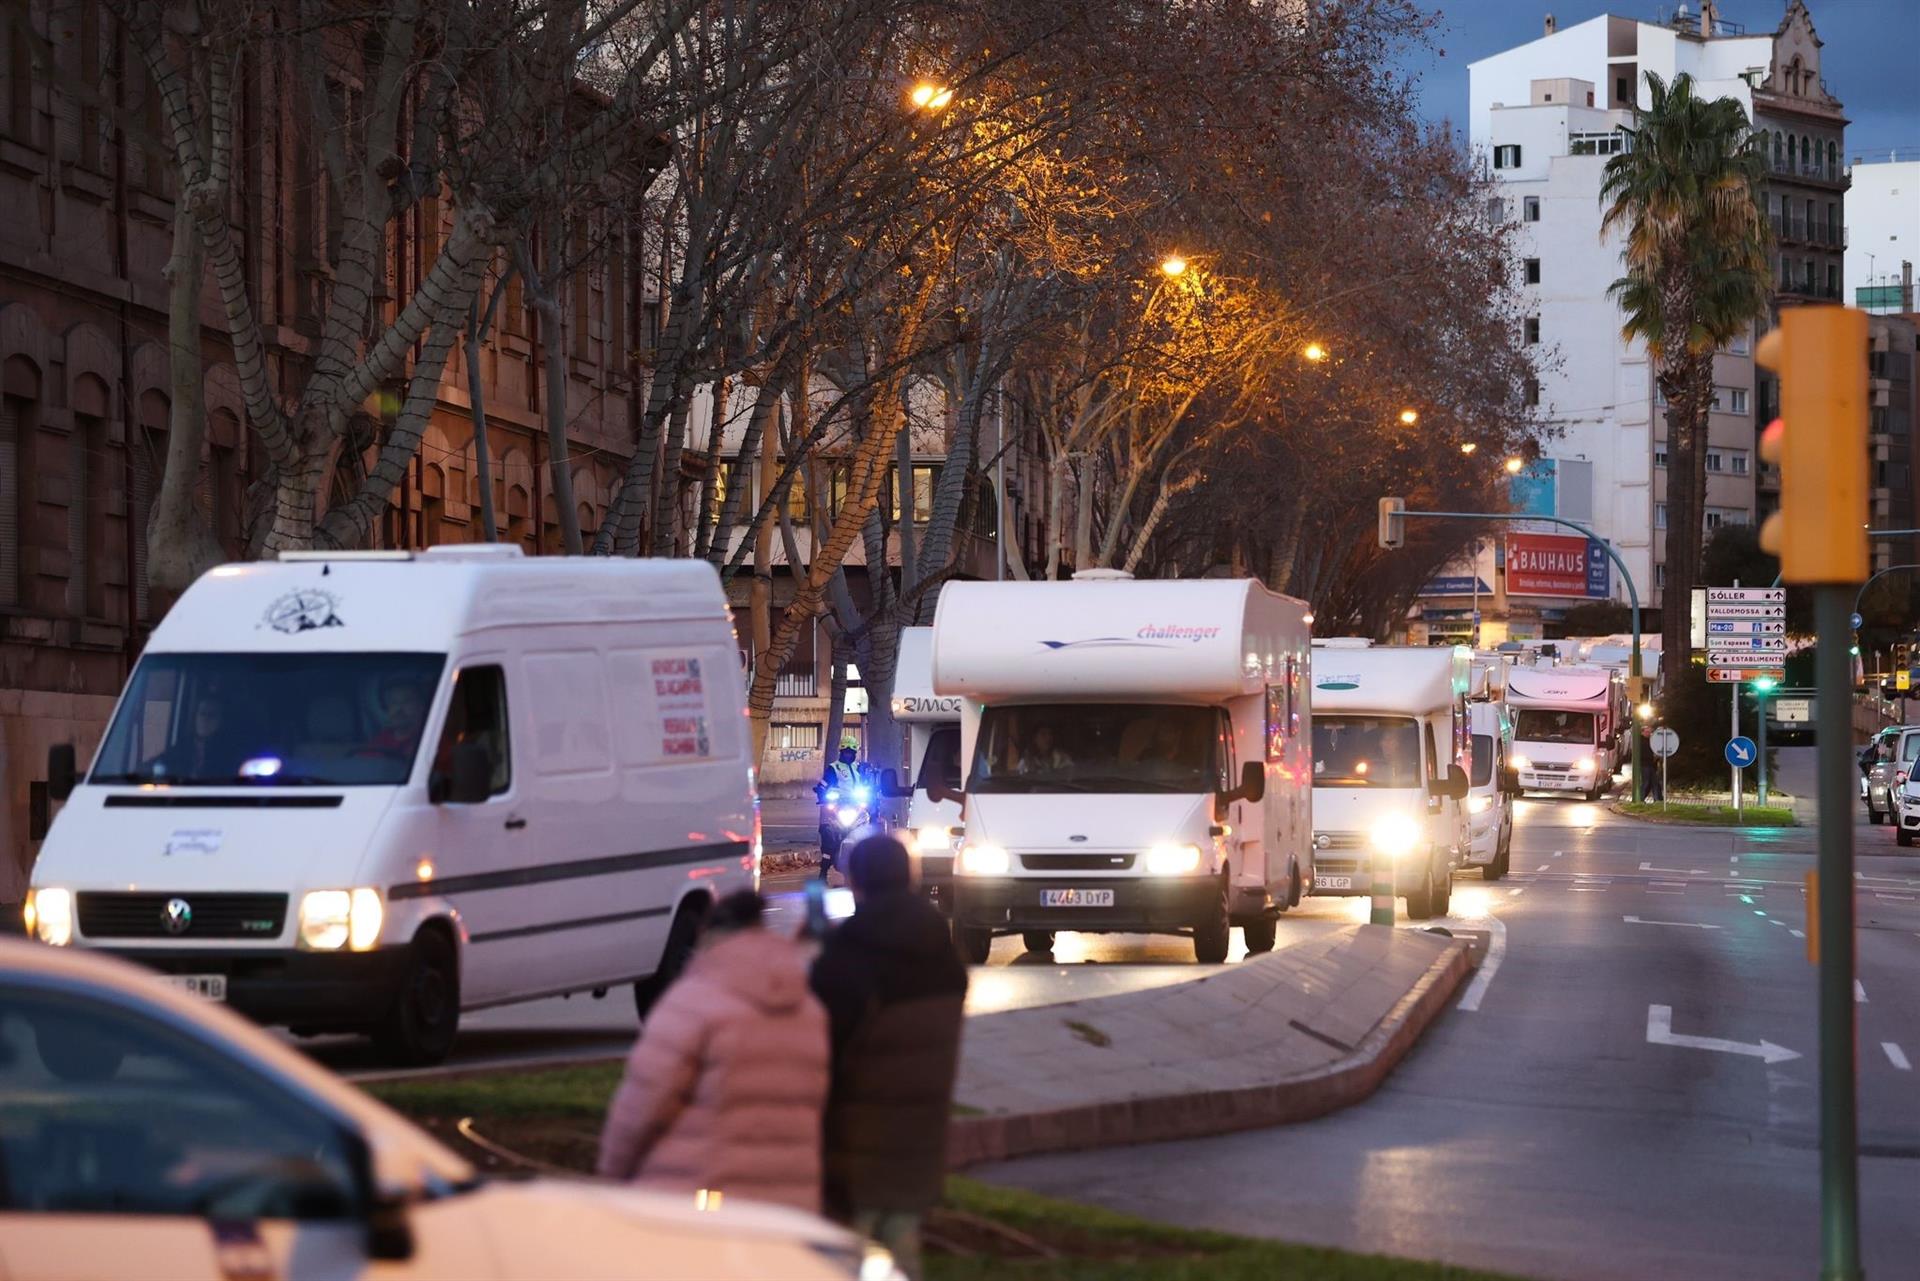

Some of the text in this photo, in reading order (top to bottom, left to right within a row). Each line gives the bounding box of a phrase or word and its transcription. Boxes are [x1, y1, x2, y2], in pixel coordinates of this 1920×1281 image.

[1520, 551, 1584, 572] BAUHAUS
[1710, 591, 1745, 600] SÓLLER
[1137, 624, 1221, 642] challenger
[1330, 878, 1349, 888] LGP
[1086, 892, 1110, 904] DYP
